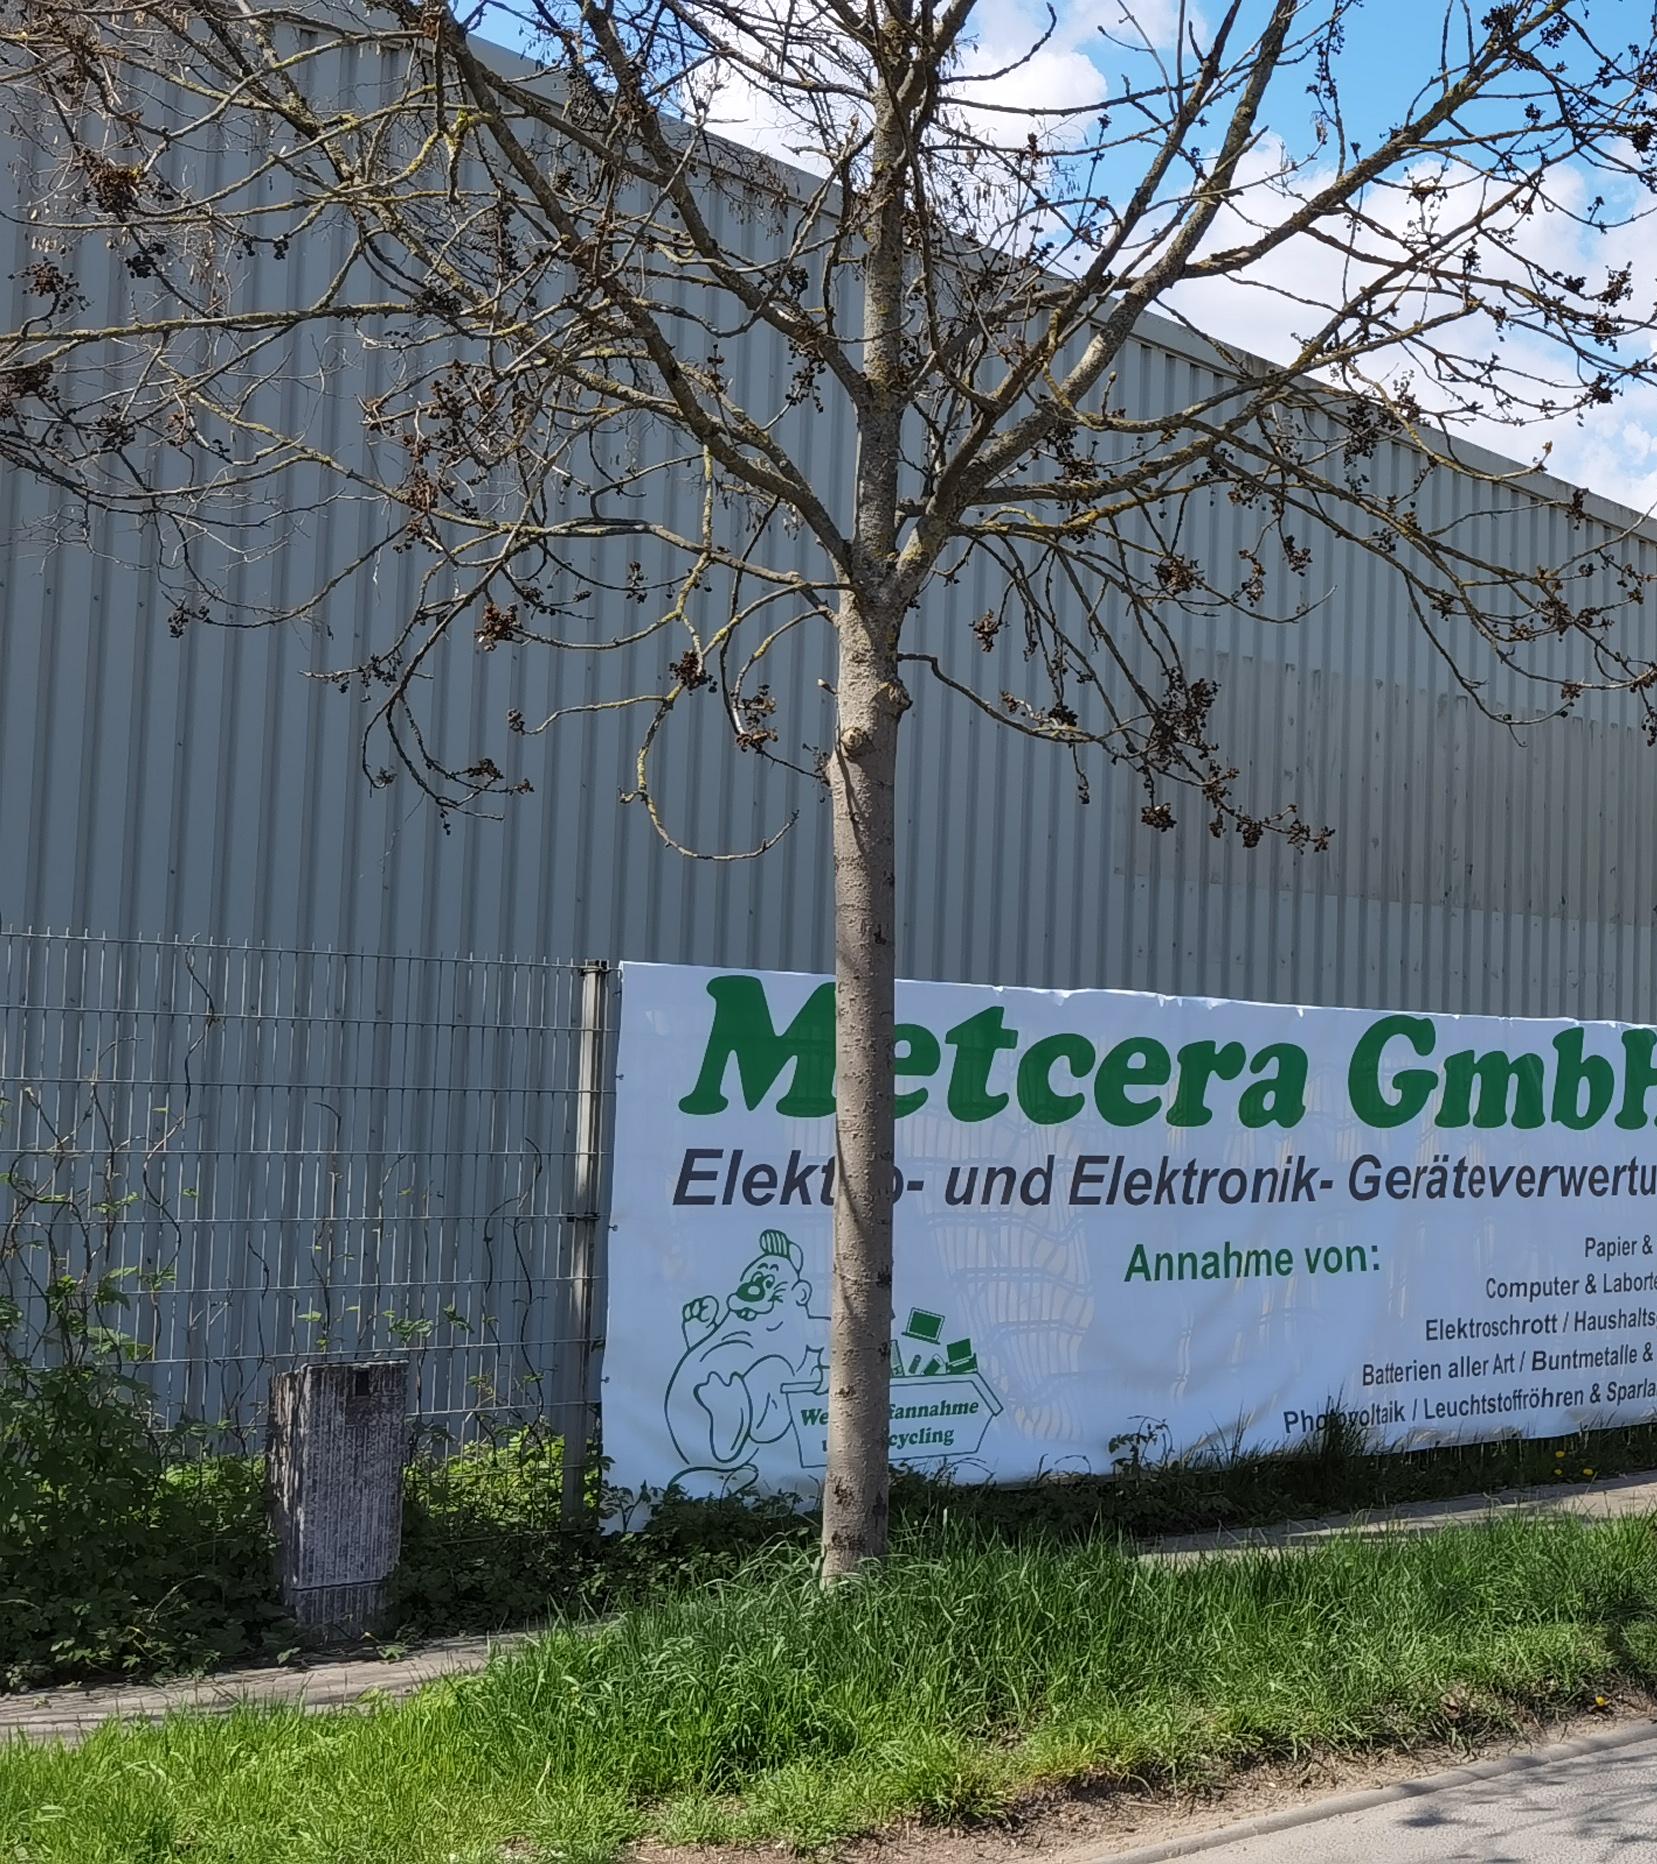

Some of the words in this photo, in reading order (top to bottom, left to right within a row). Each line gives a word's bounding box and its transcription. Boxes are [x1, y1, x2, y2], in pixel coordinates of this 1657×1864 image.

[678, 974, 1308, 1128] Metcera
[672, 1148, 924, 1207] Elekt-
[945, 1154, 1053, 1207] und
[1069, 1154, 1333, 1206] Elektronik-
[1124, 1241, 1293, 1282] Annahme
[1305, 1243, 1381, 1274] von:
[1585, 1237, 1638, 1260] Papier
[1642, 1235, 1654, 1255] &
[1486, 1276, 1579, 1302] Computer
[1585, 1275, 1597, 1294] &
[1425, 1313, 1557, 1341] Elektroschrott
[1562, 1309, 1569, 1334] /
[1362, 1359, 1442, 1387] Batterien
[1448, 1356, 1489, 1378] aller
[1493, 1353, 1515, 1375] Art
[1519, 1351, 1525, 1373] /
[1532, 1344, 1638, 1372] Buntmetalle
[1642, 1343, 1654, 1363] &
[1423, 1388, 1584, 1421] Leuchtstoffröhren
[1589, 1384, 1601, 1403] &
